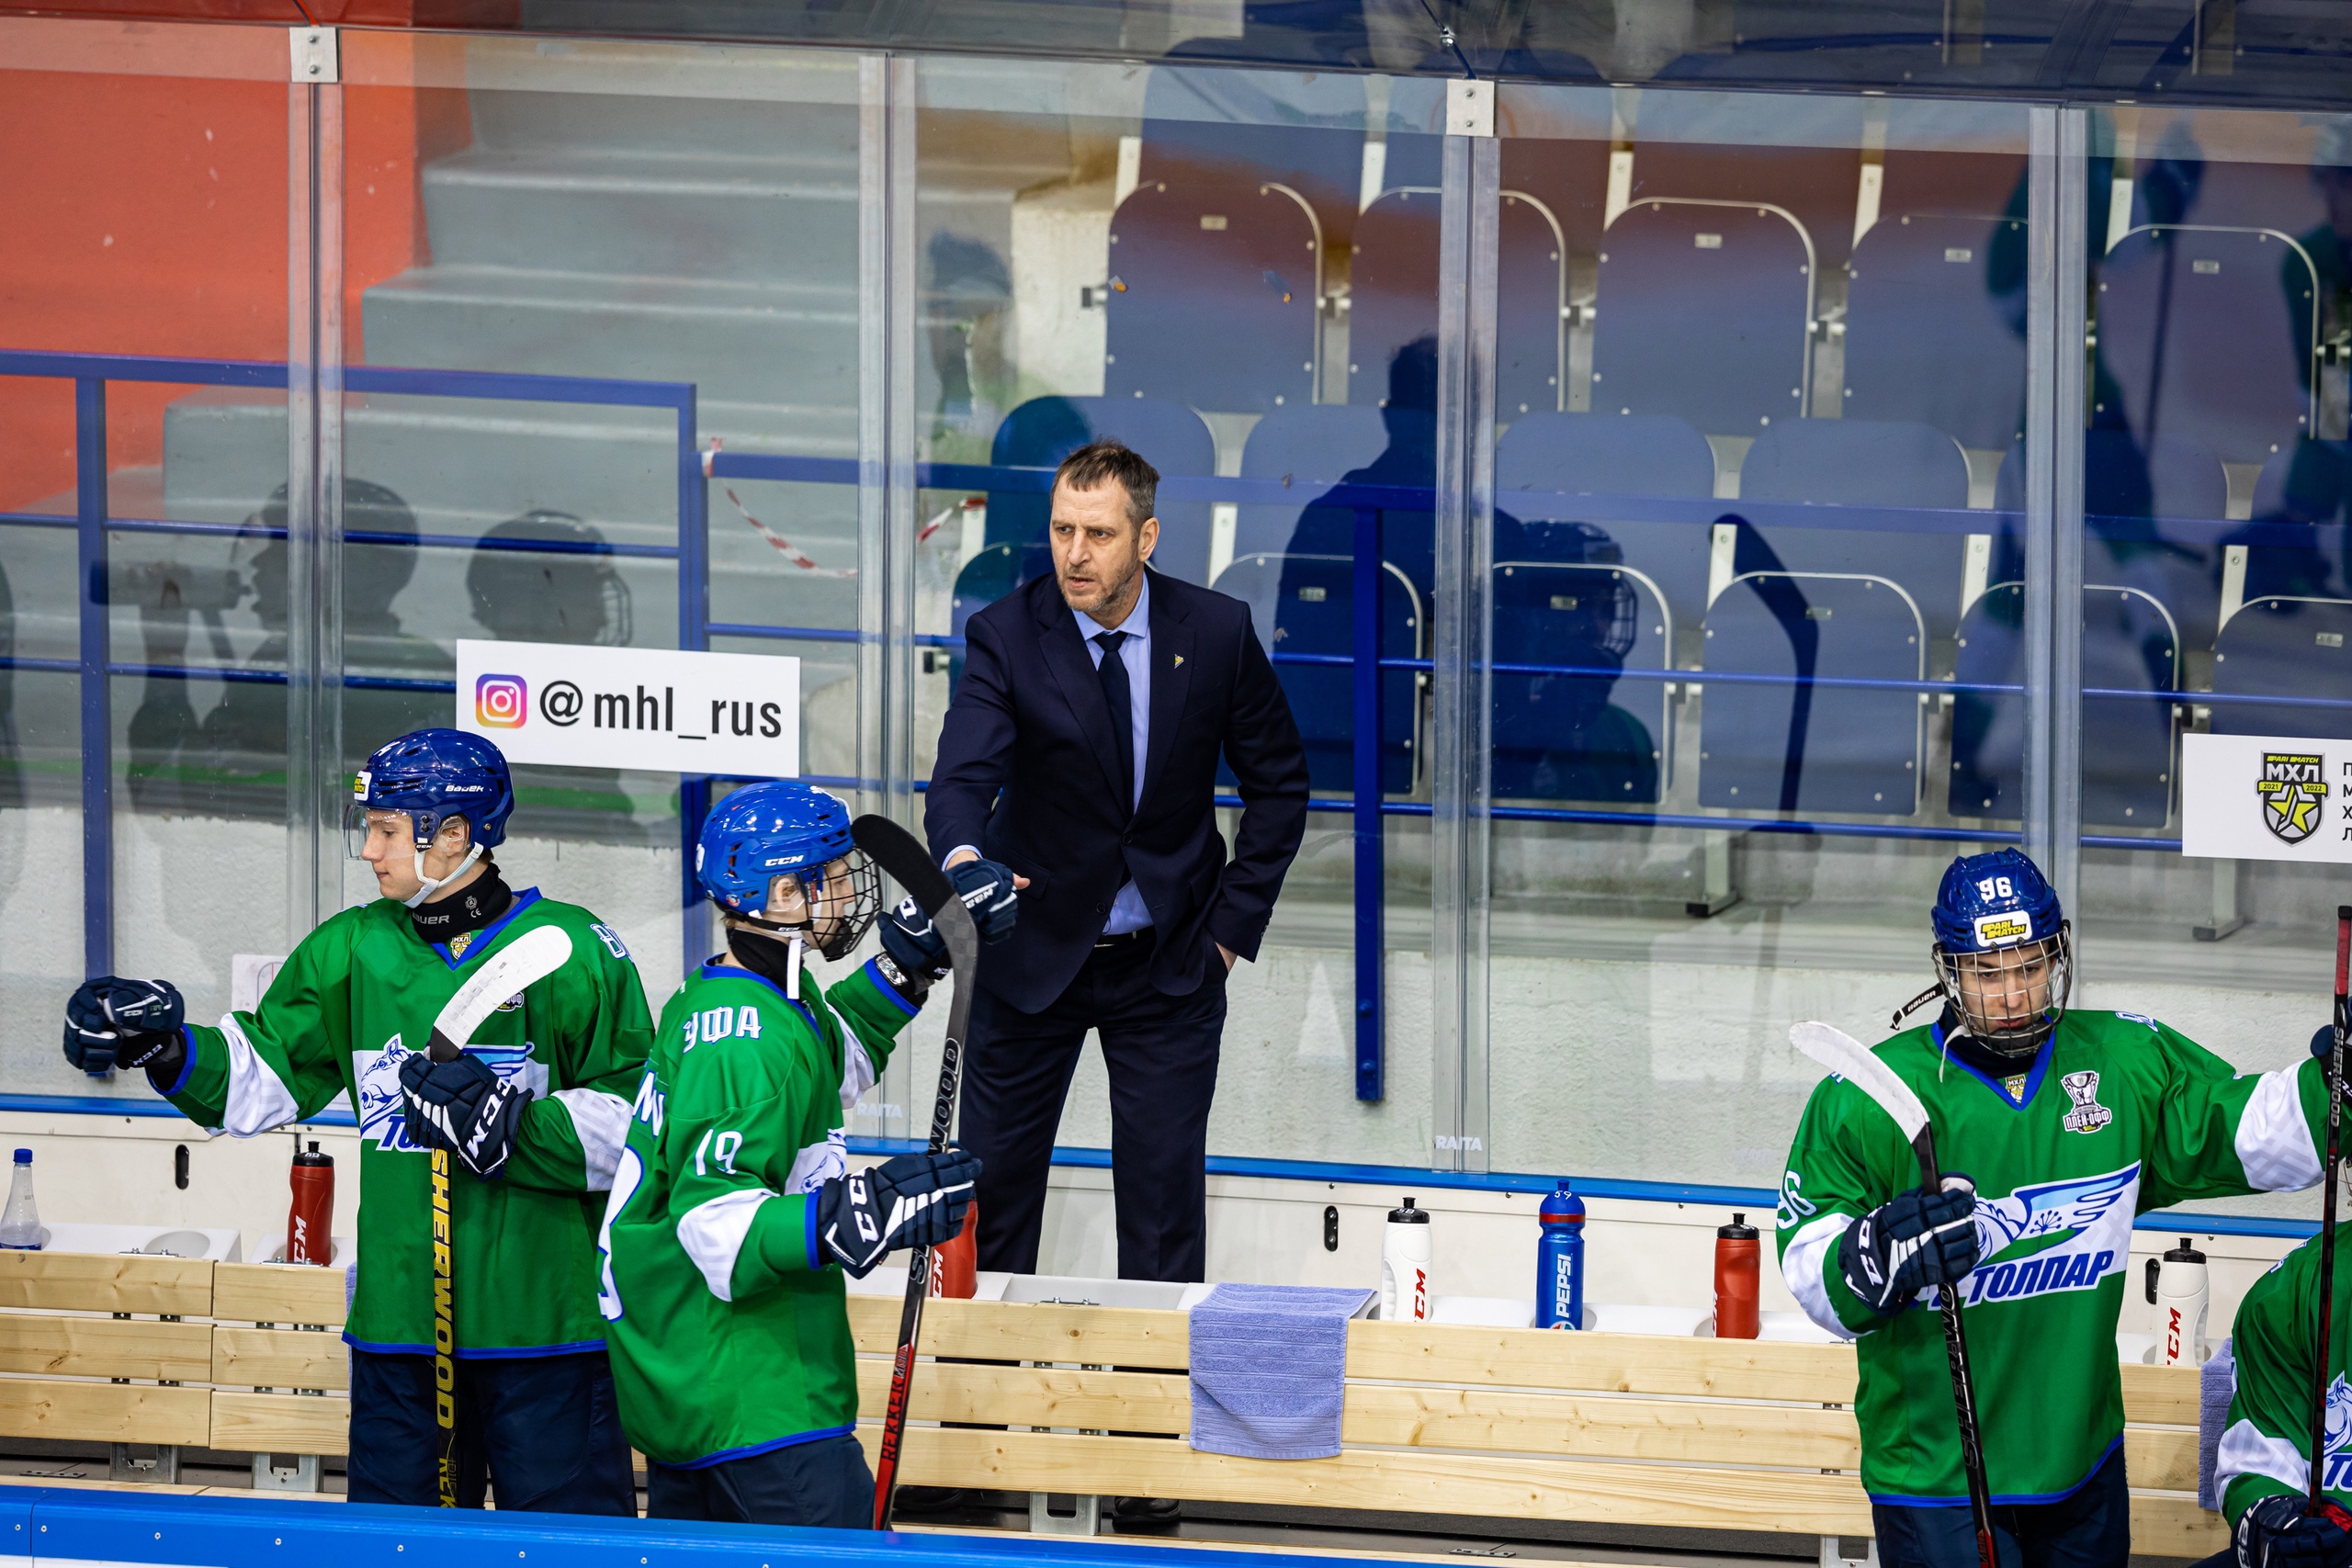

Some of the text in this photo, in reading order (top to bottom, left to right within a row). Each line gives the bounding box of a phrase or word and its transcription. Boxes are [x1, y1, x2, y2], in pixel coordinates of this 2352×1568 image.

[2267, 763, 2319, 782] МХЛ
[764, 855, 804, 866] CCM
[1979, 876, 2012, 901] 96
[1982, 920, 2011, 932] PARI
[1986, 925, 2026, 939] MATCH
[682, 1005, 764, 1054] УФА
[467, 1077, 512, 1159] CCM
[856, 1101, 903, 1119] RAITA
[695, 1128, 743, 1177] 19
[1435, 1134, 1483, 1151] RAITA
[294, 1214, 307, 1264] CM
[933, 1249, 944, 1298] CM
[1414, 1268, 1426, 1322] CM
[1555, 1253, 1572, 1319] PEPSI
[1968, 1250, 2115, 1304] ТОЛПАР
[2166, 1306, 2181, 1366] CM
[880, 1379, 904, 1462] REKKER
